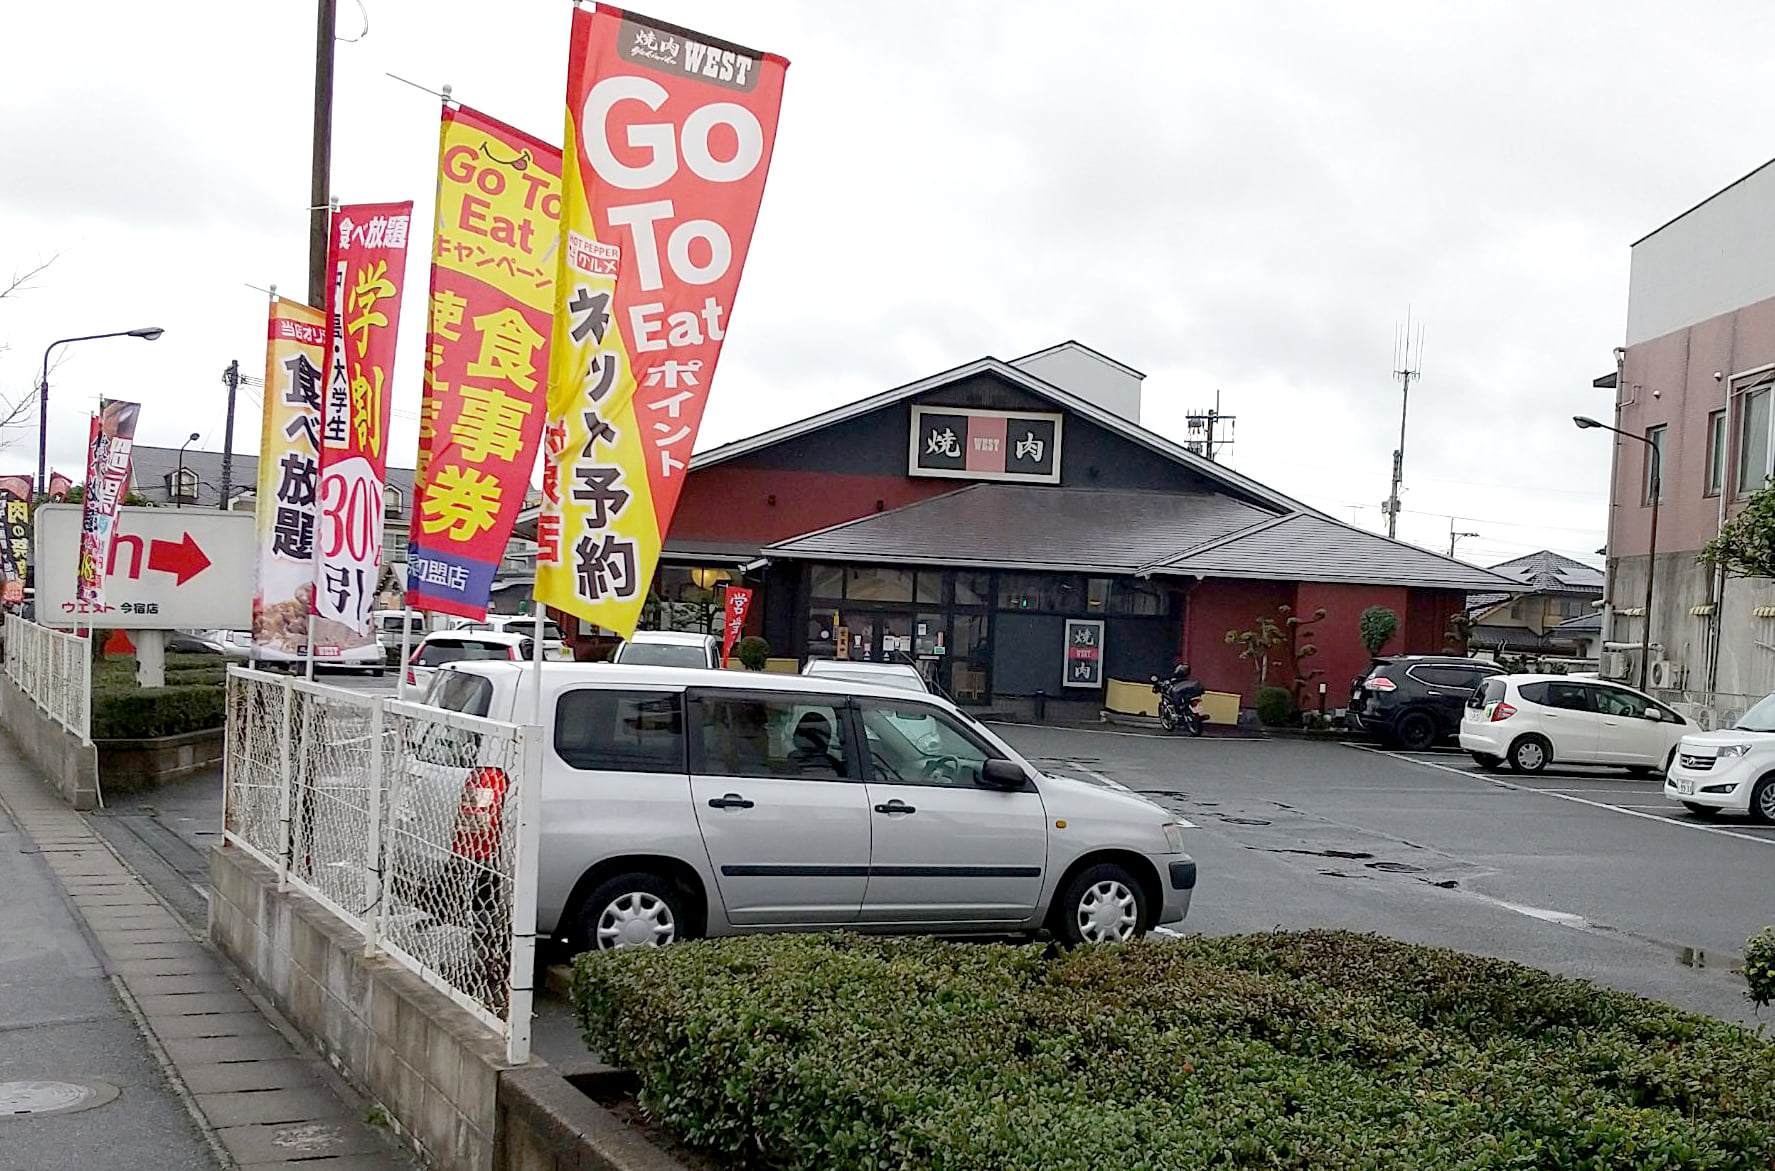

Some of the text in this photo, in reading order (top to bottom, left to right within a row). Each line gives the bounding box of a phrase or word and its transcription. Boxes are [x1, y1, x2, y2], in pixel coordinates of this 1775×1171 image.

[634, 29, 752, 85] 焼肉 WEST
[339, 215, 410, 250] 食べ放題
[457, 192, 537, 256] Eat
[583, 241, 619, 258] PEPPER
[437, 233, 553, 289] キャンペーン
[281, 319, 327, 344] 当店オリ
[628, 296, 726, 353] Eat
[347, 259, 398, 458] 学割
[420, 306, 546, 543] 食事券
[568, 287, 638, 601] ネット予約
[646, 360, 704, 478] ポイント
[973, 437, 1000, 452] WEST
[1015, 430, 1044, 462] 肉
[272, 353, 323, 560] 食べ放題
[120, 602, 160, 614] 今宿店
[1075, 662, 1091, 679] 肉
